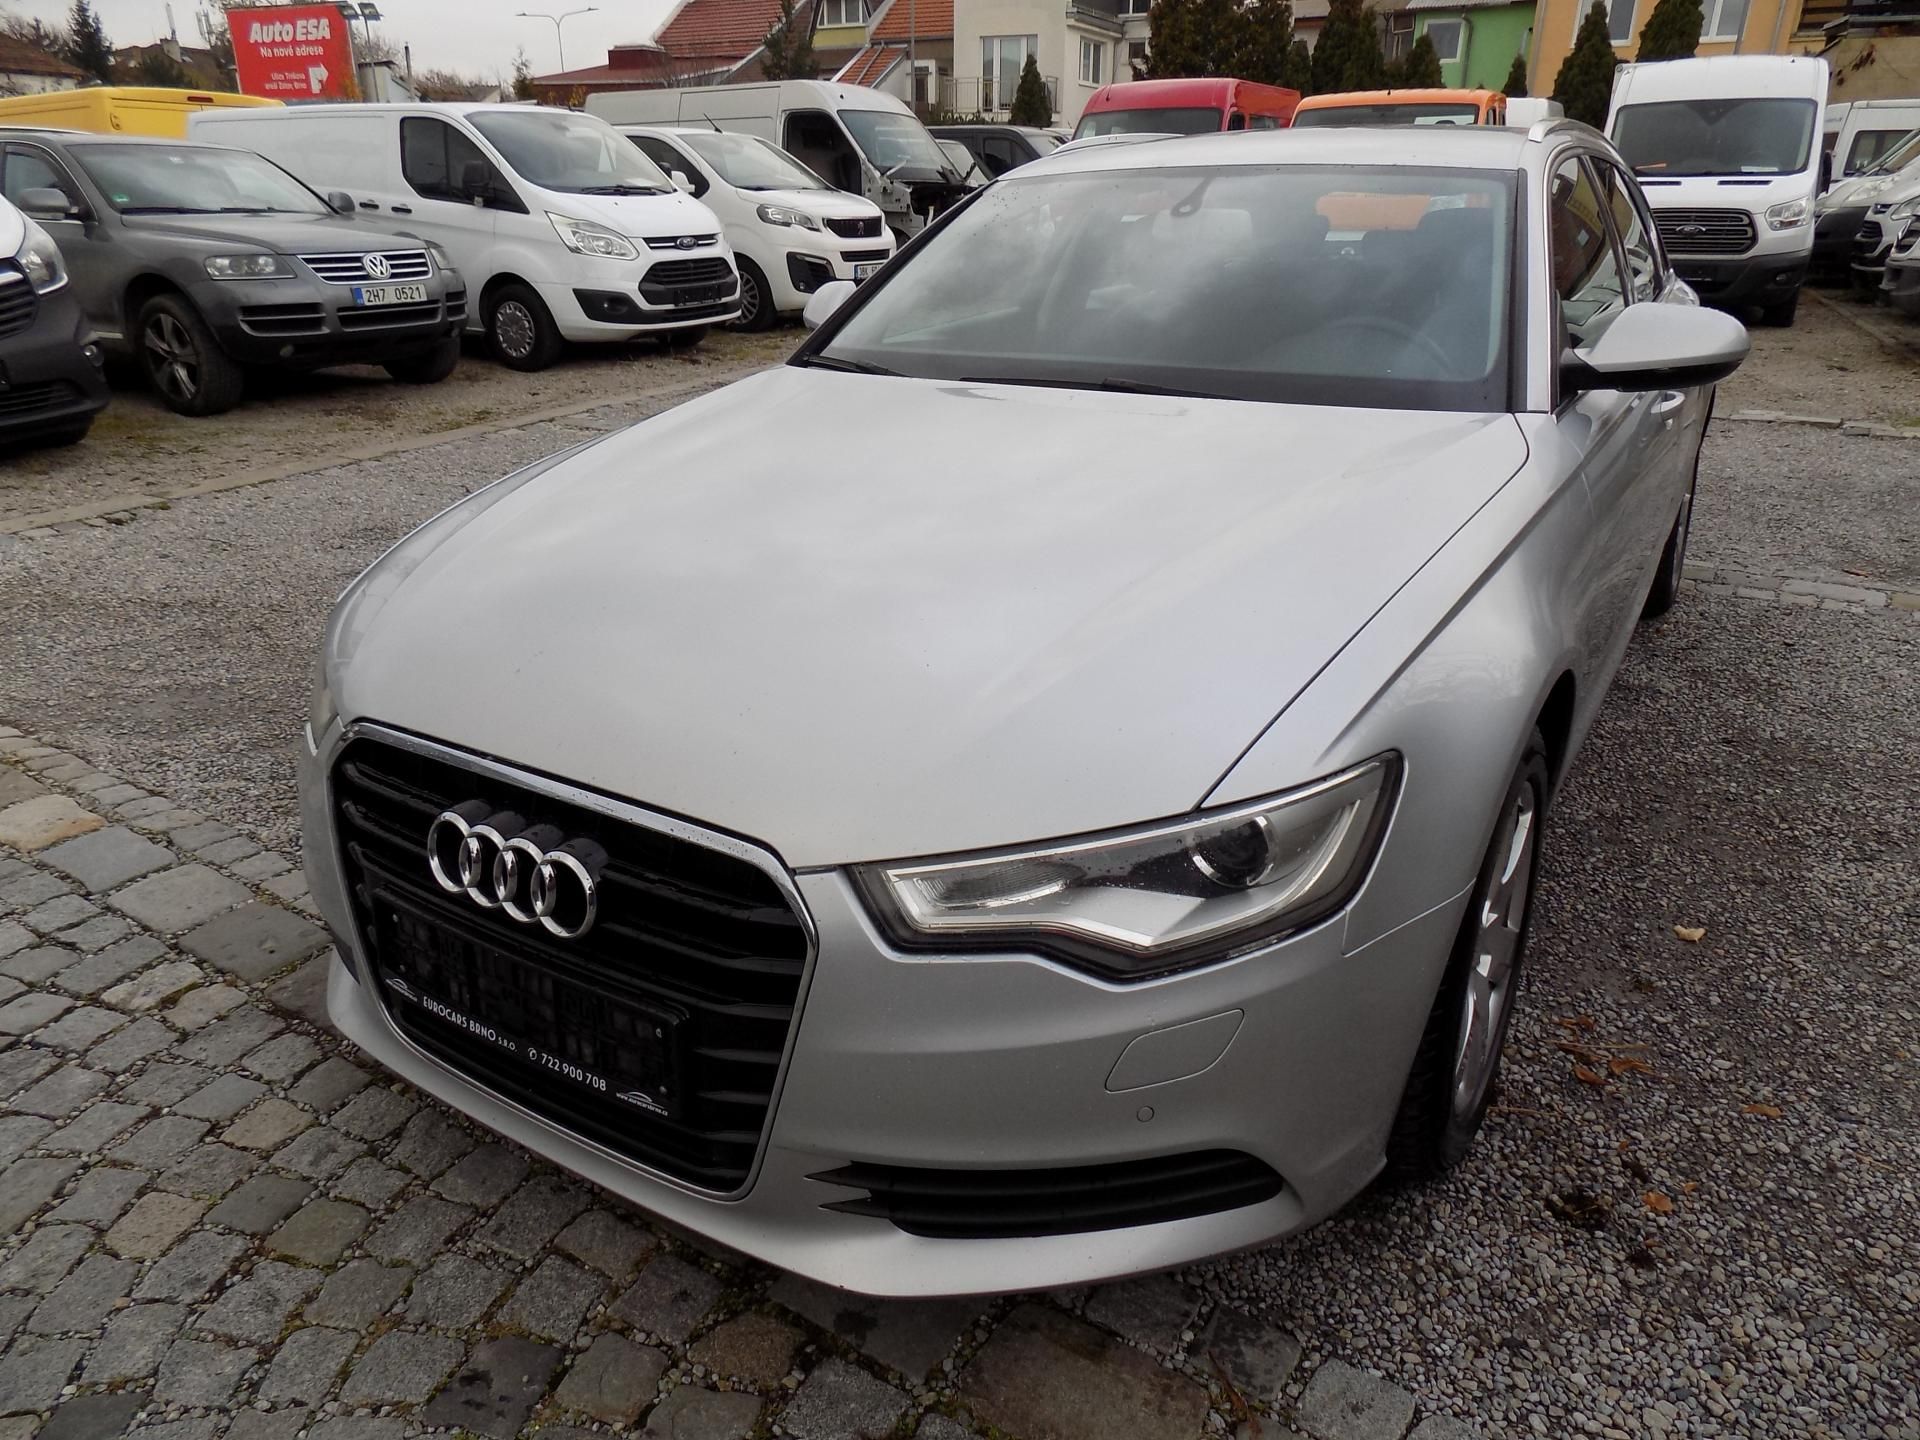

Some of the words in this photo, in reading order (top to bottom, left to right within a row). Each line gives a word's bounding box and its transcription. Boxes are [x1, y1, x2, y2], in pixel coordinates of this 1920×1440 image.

[249, 21, 294, 43] Auto
[295, 18, 331, 41] ESA
[260, 46, 272, 58] Na
[273, 45, 294, 57] nové
[296, 45, 324, 56] adrese
[365, 288, 386, 303] 2H7
[394, 286, 422, 301] 0521
[423, 996, 467, 1028] EUROCARS
[469, 1020, 496, 1041] BRNO
[541, 1053, 560, 1072] 722
[562, 1063, 583, 1081] 900
[585, 1072, 607, 1091] 708
